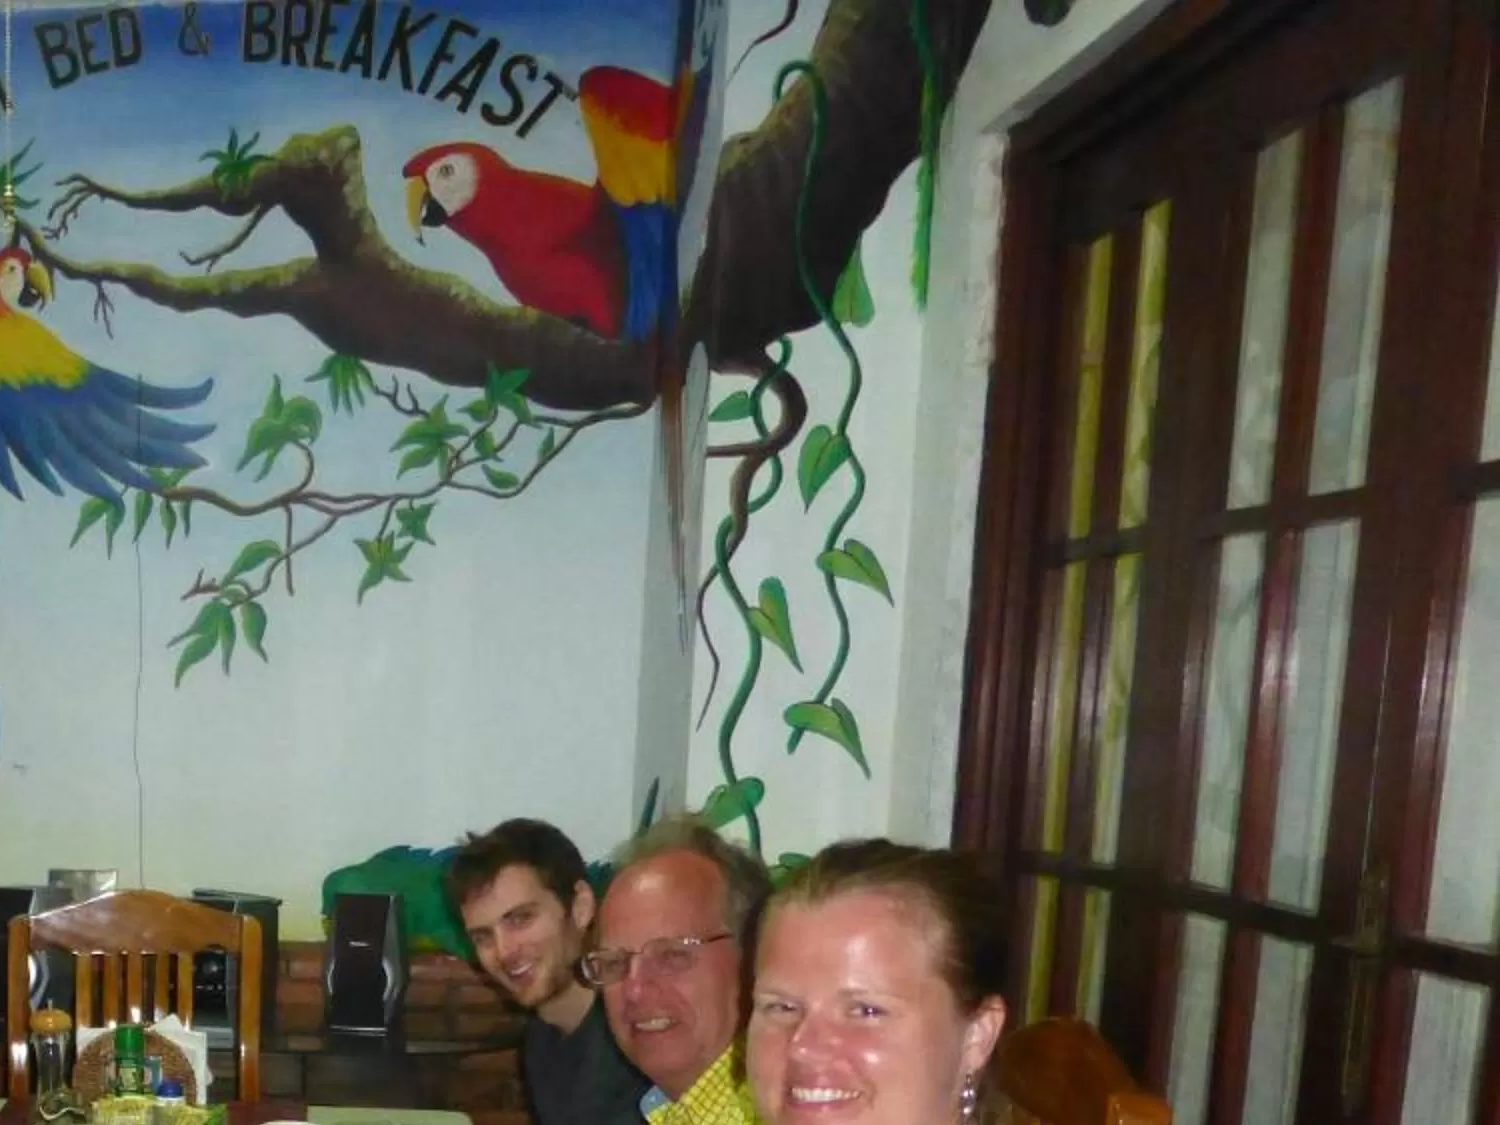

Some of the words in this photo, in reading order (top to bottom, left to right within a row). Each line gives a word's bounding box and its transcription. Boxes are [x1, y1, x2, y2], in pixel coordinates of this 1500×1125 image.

[33, 7, 142, 89] BED
[177, 3, 210, 56] &
[243, 0, 578, 138] BREAKFAST
